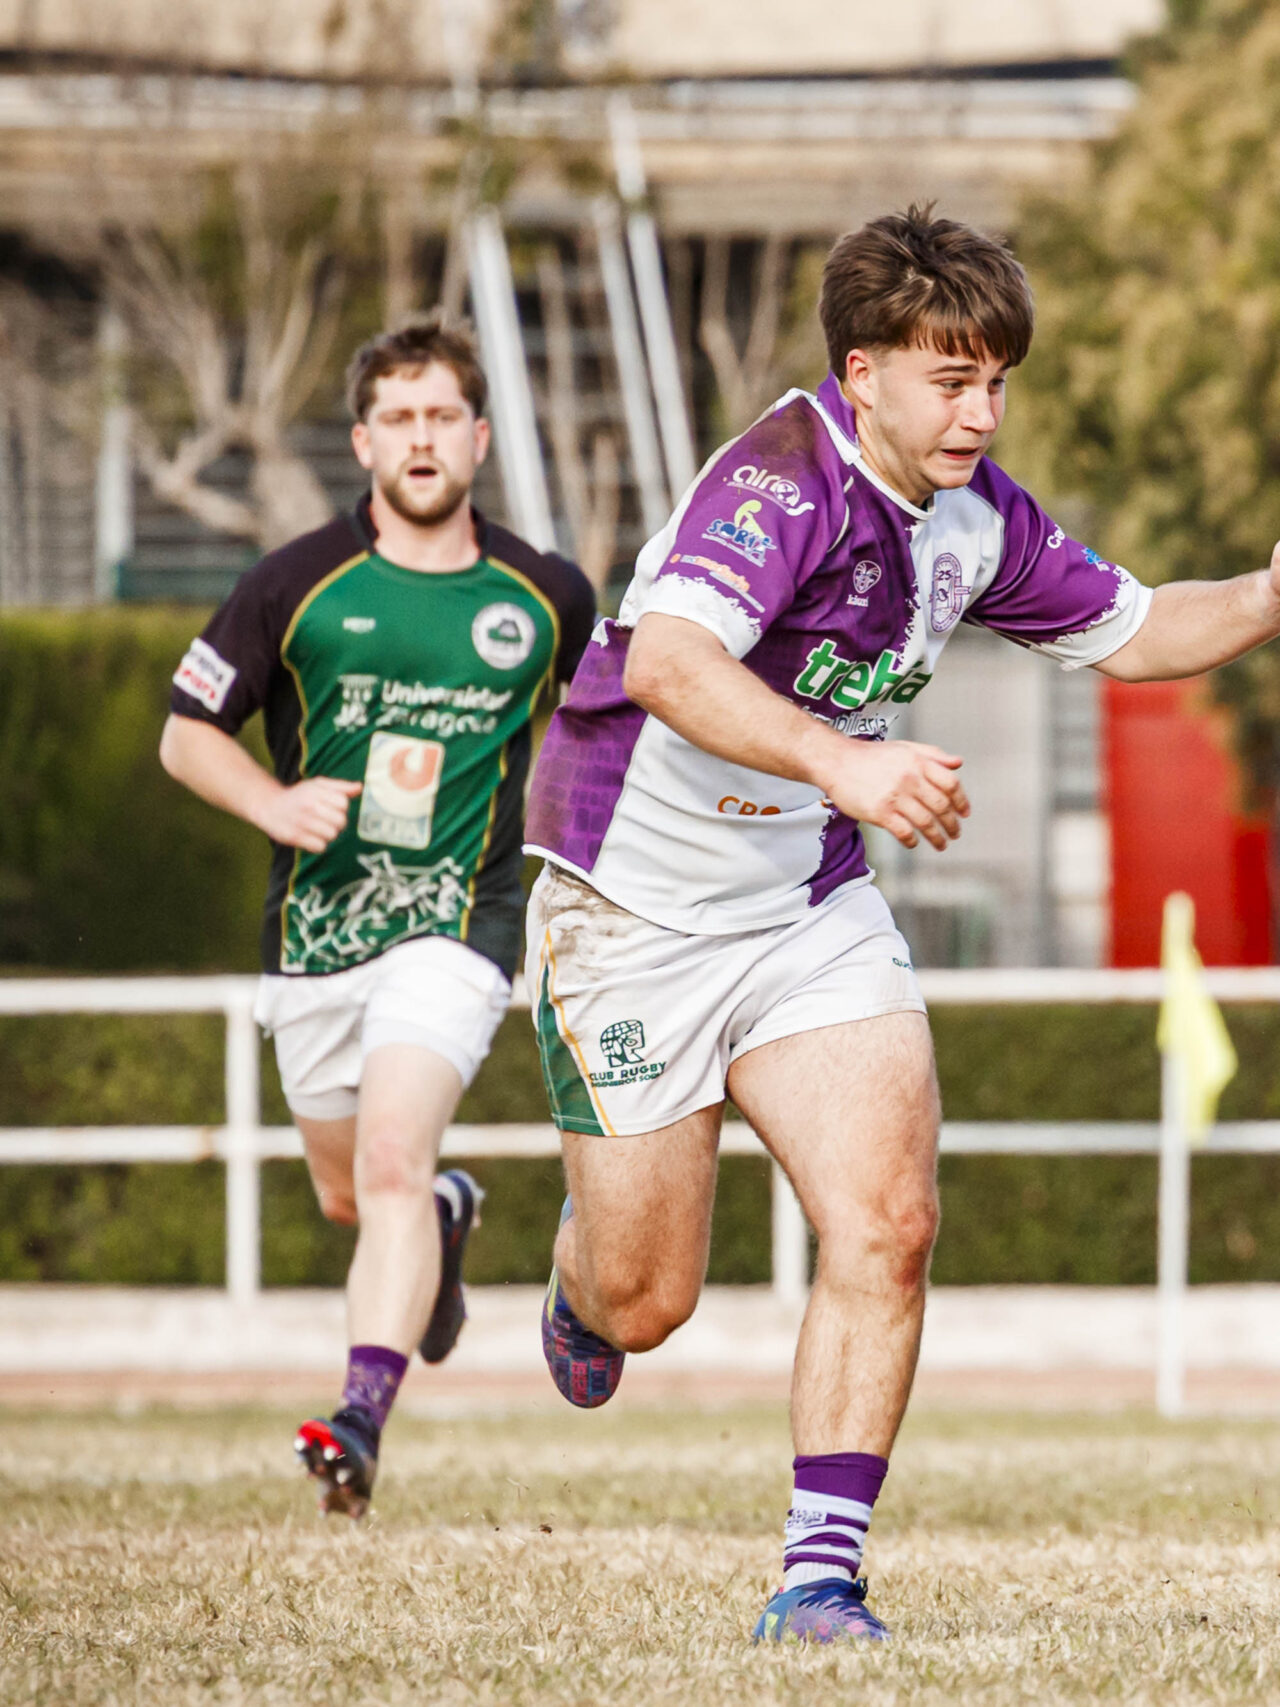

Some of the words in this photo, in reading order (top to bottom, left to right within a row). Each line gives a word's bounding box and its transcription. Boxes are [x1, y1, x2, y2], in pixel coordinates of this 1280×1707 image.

[939, 569, 954, 581] 25
[590, 1071, 614, 1081] CLUB
[621, 1061, 667, 1079] RUGBY
